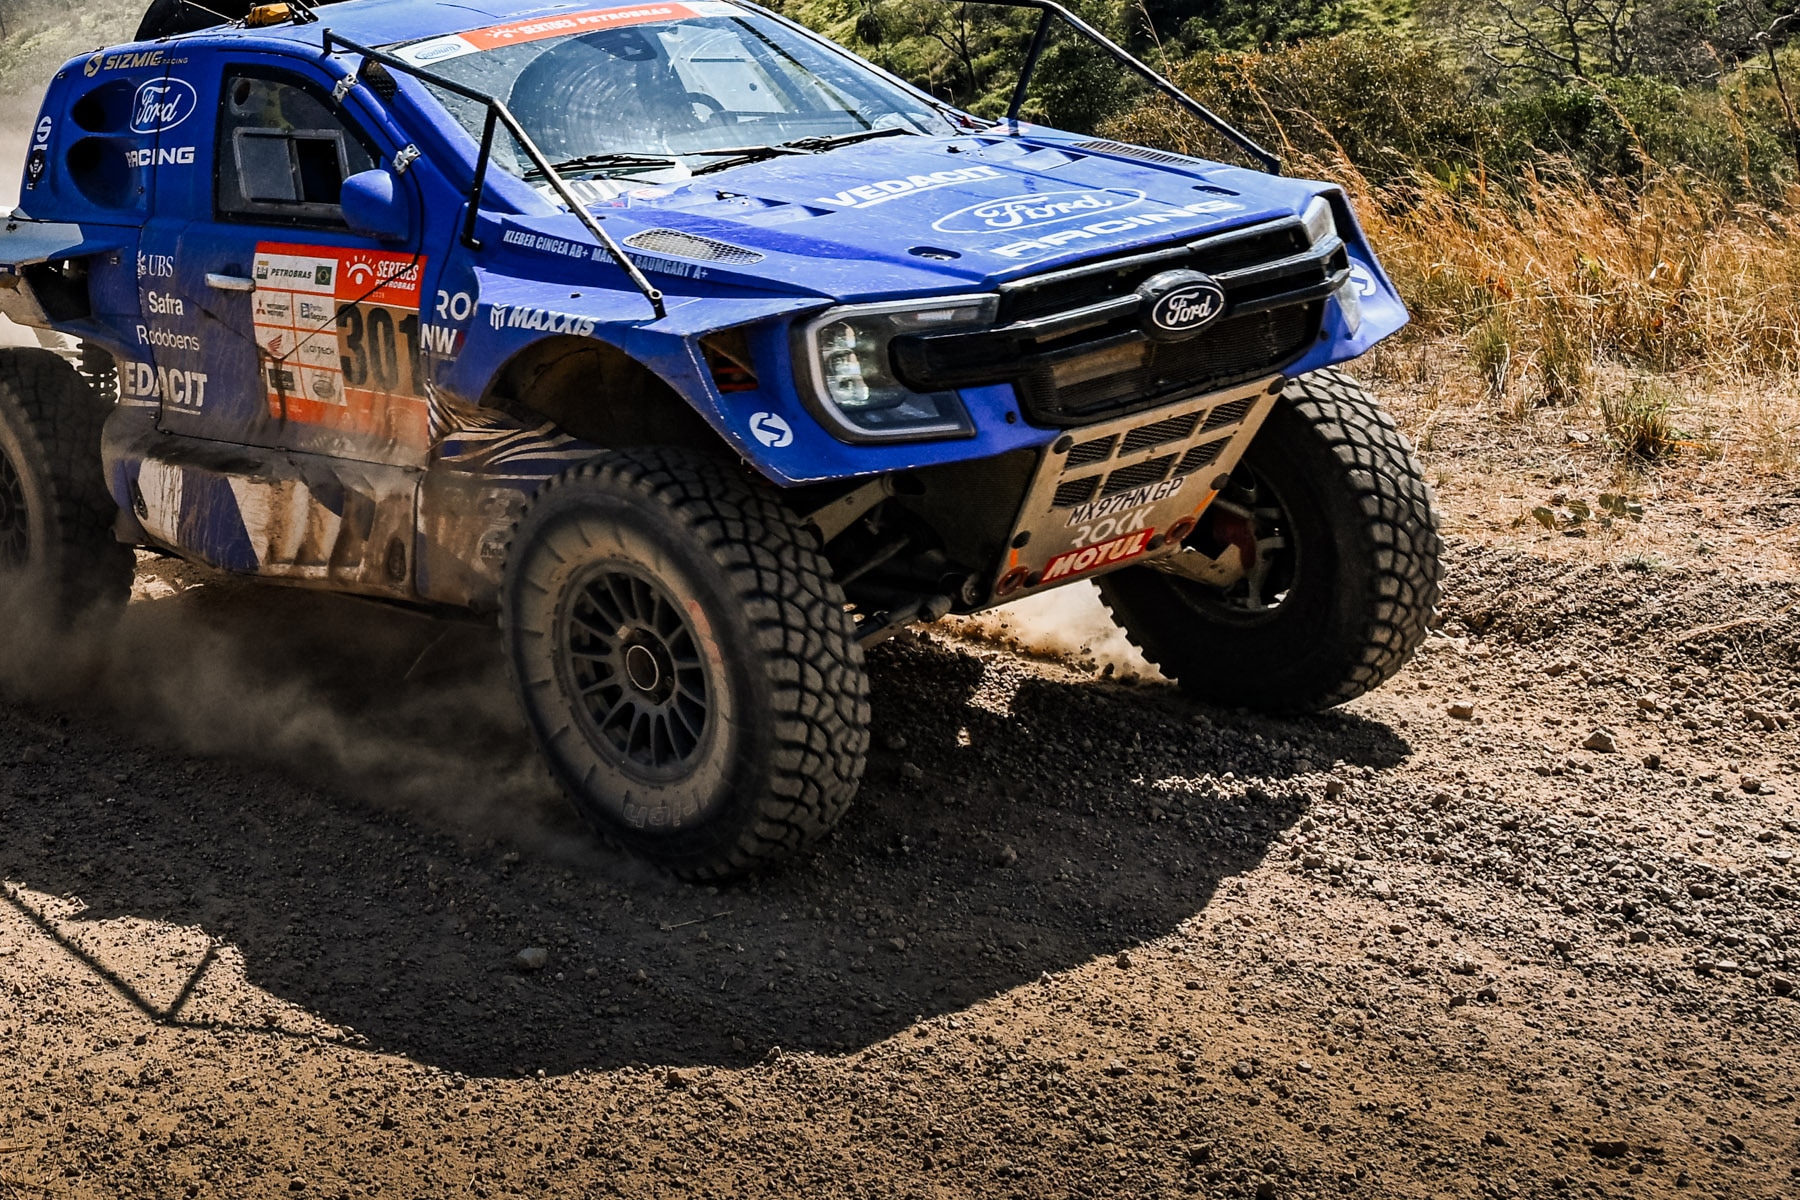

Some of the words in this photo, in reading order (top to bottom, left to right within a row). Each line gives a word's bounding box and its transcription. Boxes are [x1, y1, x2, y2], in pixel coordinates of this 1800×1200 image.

[577, 7, 673, 25] PETROBRAS
[135, 86, 182, 126] Ford
[817, 165, 1002, 207] VEDACIT
[974, 195, 1114, 228] Ford
[989, 199, 1235, 259] RACING
[148, 254, 174, 278] UBS
[503, 229, 536, 248] KLEBER
[535, 235, 569, 256] CINCEA
[569, 244, 589, 259] AB+
[635, 255, 692, 277] BAUMGART
[693, 266, 708, 280] A+
[270, 268, 313, 279] PETROBRAS
[148, 290, 184, 316] Safra
[507, 306, 596, 336] MAXXIS
[1165, 291, 1212, 325] Ford
[136, 324, 200, 351] Rodobens
[336, 302, 425, 398] 301
[124, 361, 208, 407] EDACIT
[1066, 488, 1150, 528] MX97HN
[1042, 532, 1146, 582] MOTUL
